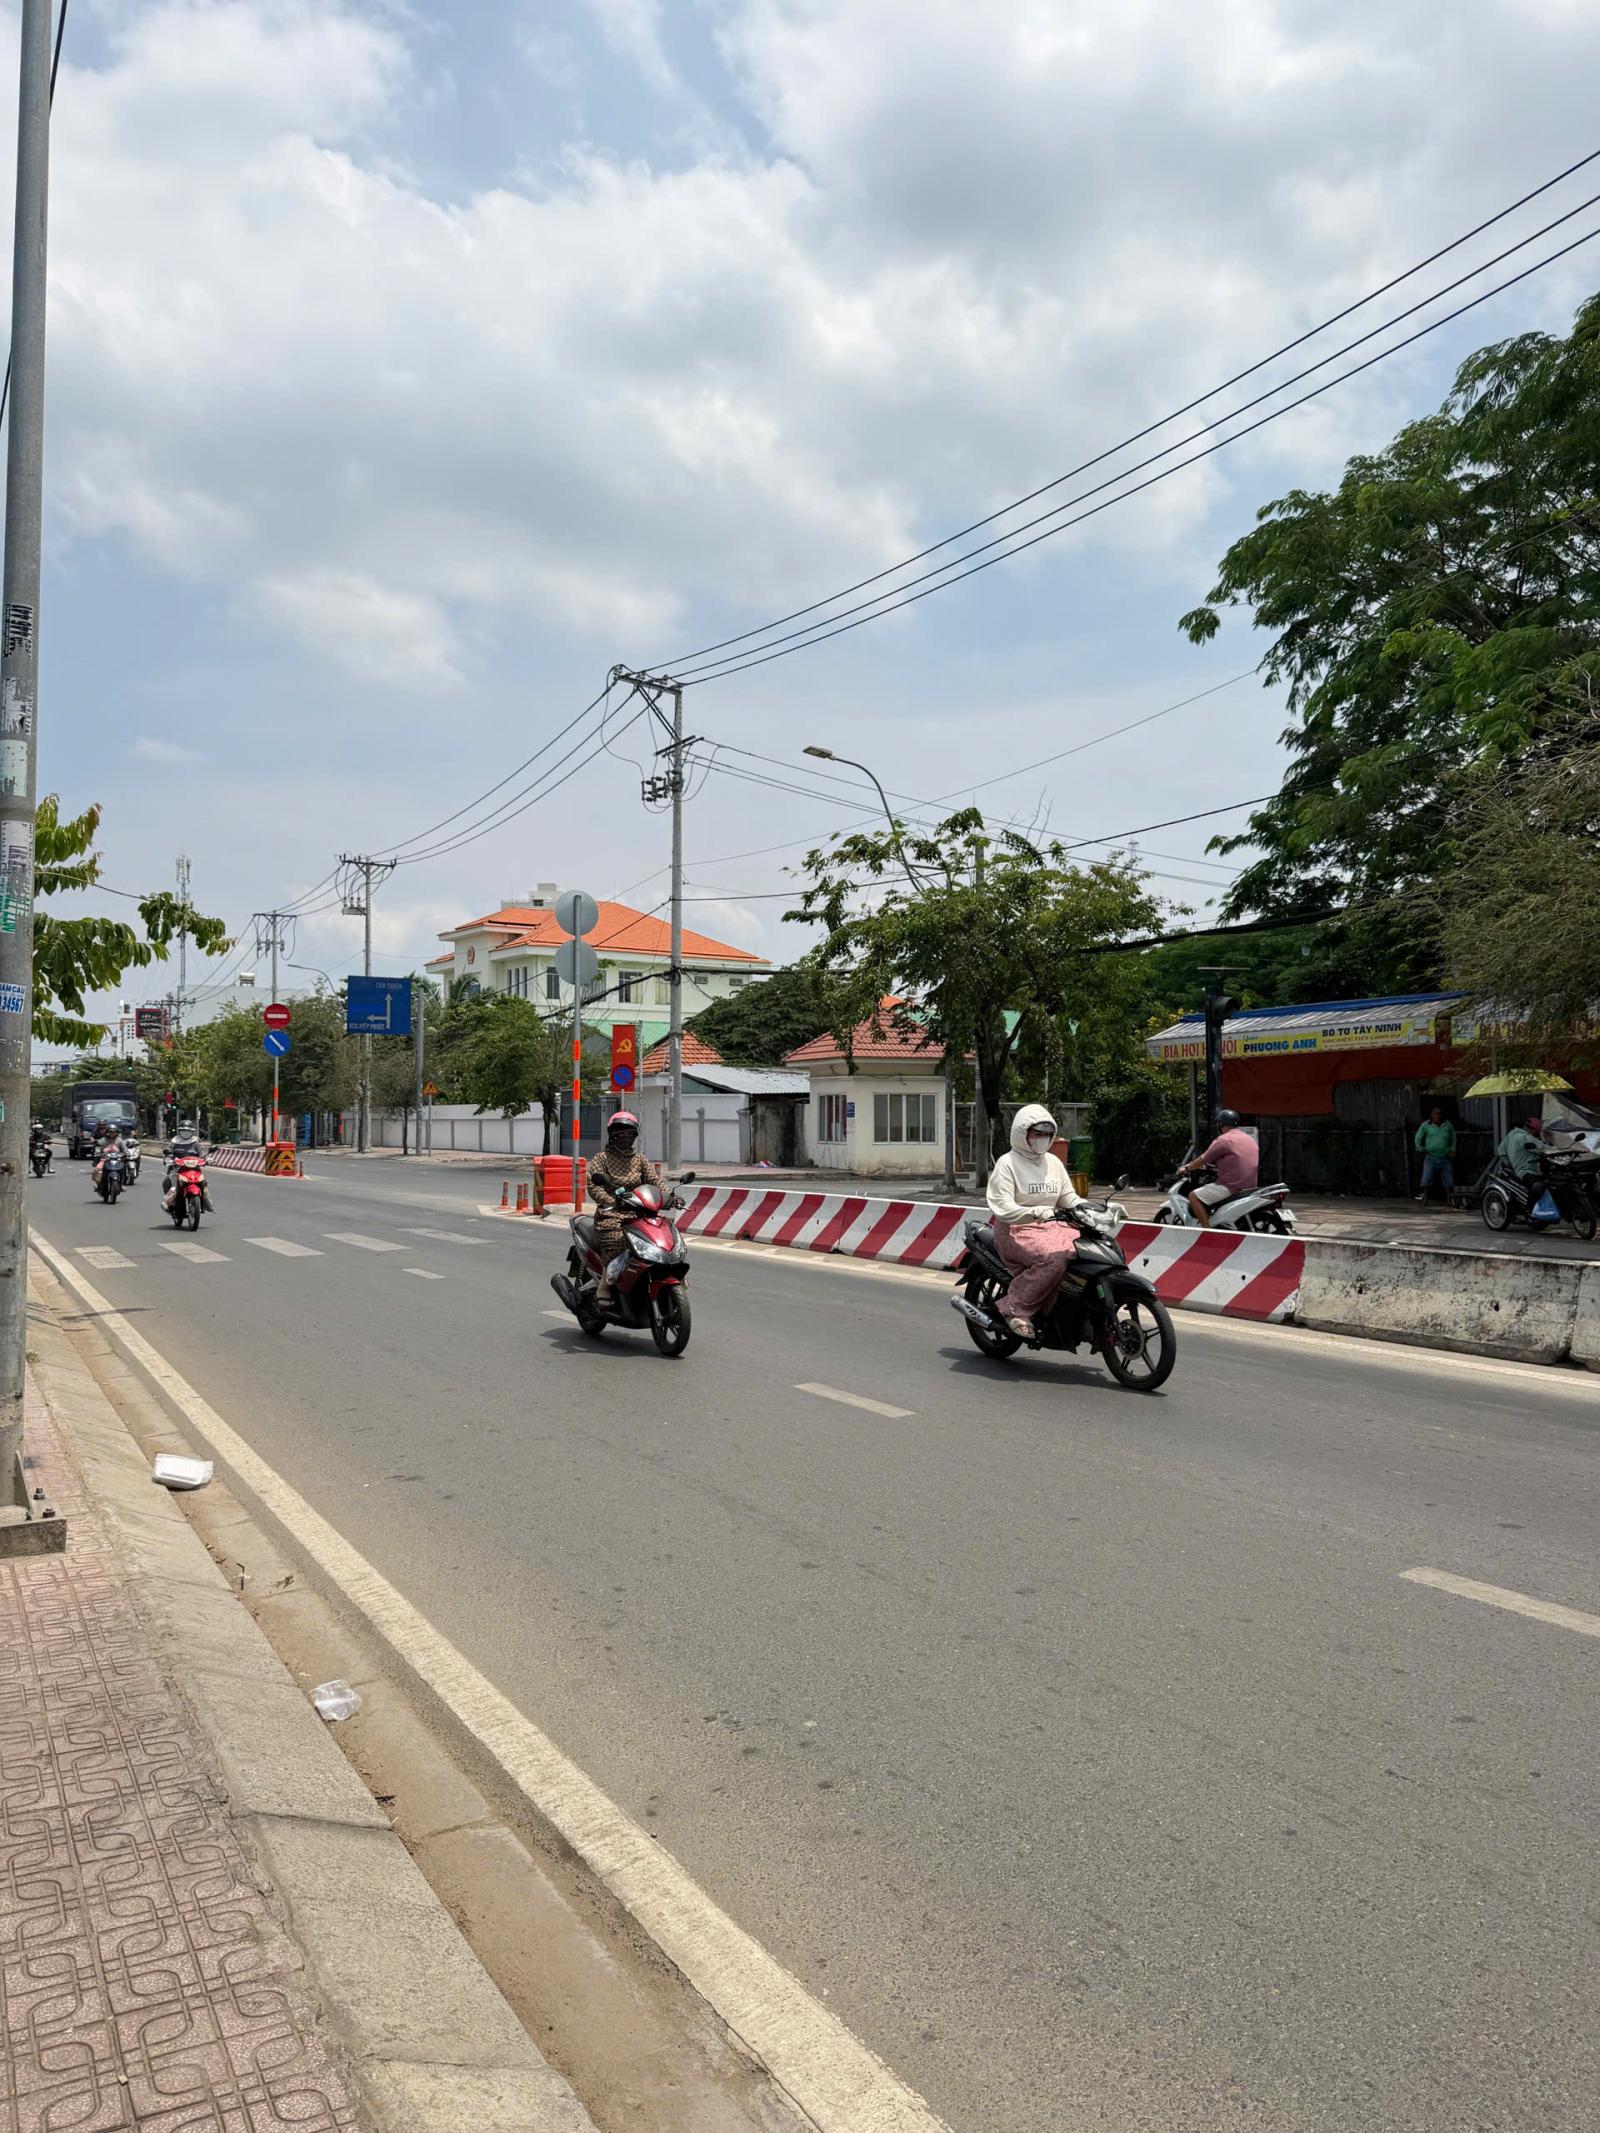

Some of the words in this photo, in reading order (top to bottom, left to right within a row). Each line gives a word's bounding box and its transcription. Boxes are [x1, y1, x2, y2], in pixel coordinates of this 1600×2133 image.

[1375, 1022, 1401, 1032] NINH
[1292, 1038, 1317, 1050] ANH
[1164, 1044, 1179, 1059] BIA
